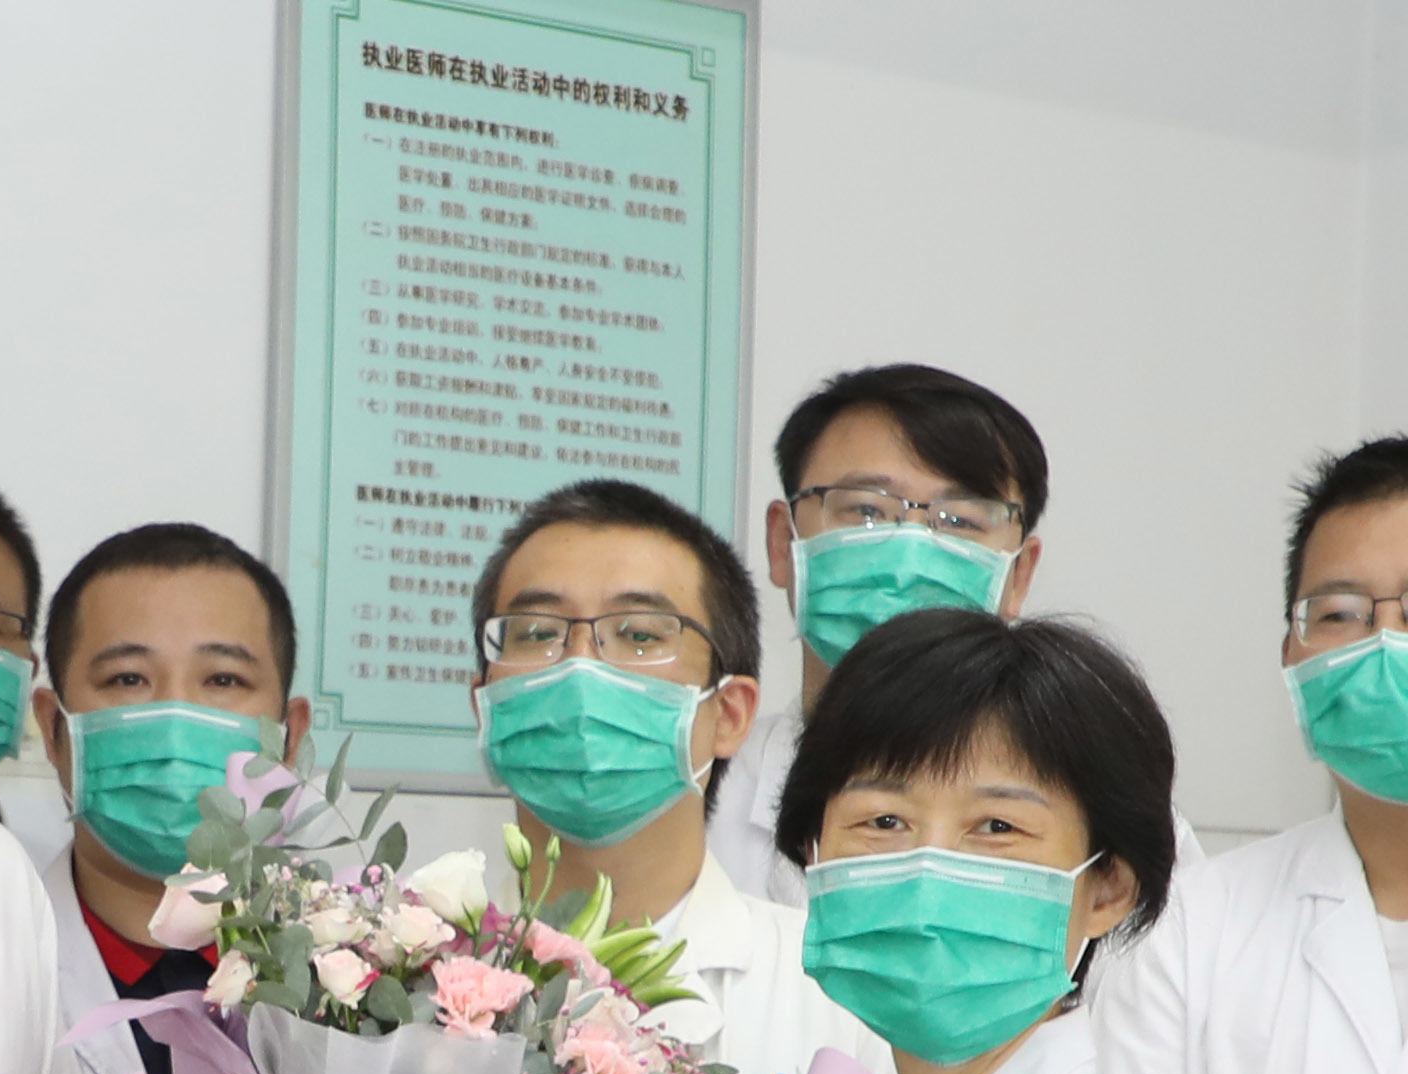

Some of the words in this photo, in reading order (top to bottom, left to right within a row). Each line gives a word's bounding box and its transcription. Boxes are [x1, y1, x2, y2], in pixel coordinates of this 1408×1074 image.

[362, 40, 689, 122] 执业医师在执业活动中的权利和义务
[357, 483, 531, 515] 医师在执业活动中履行下列
